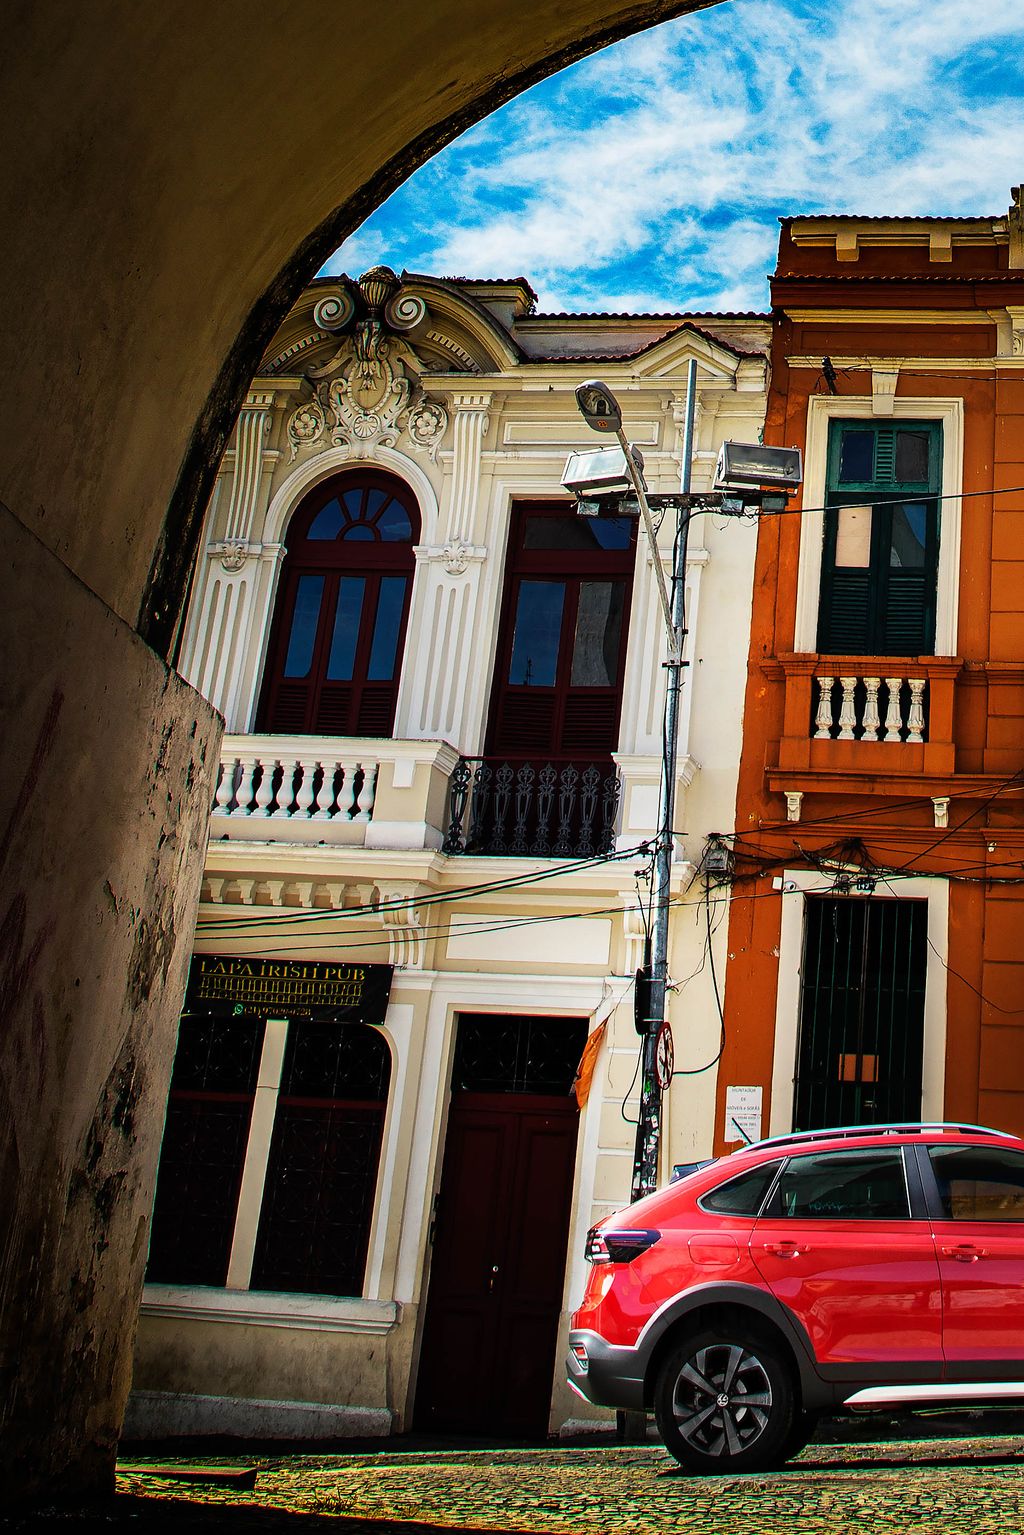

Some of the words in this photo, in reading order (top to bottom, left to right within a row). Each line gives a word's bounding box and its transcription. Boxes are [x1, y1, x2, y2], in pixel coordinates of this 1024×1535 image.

[201, 961, 253, 976] LAPA
[260, 964, 318, 979] IRISH
[324, 968, 366, 981] PUB
